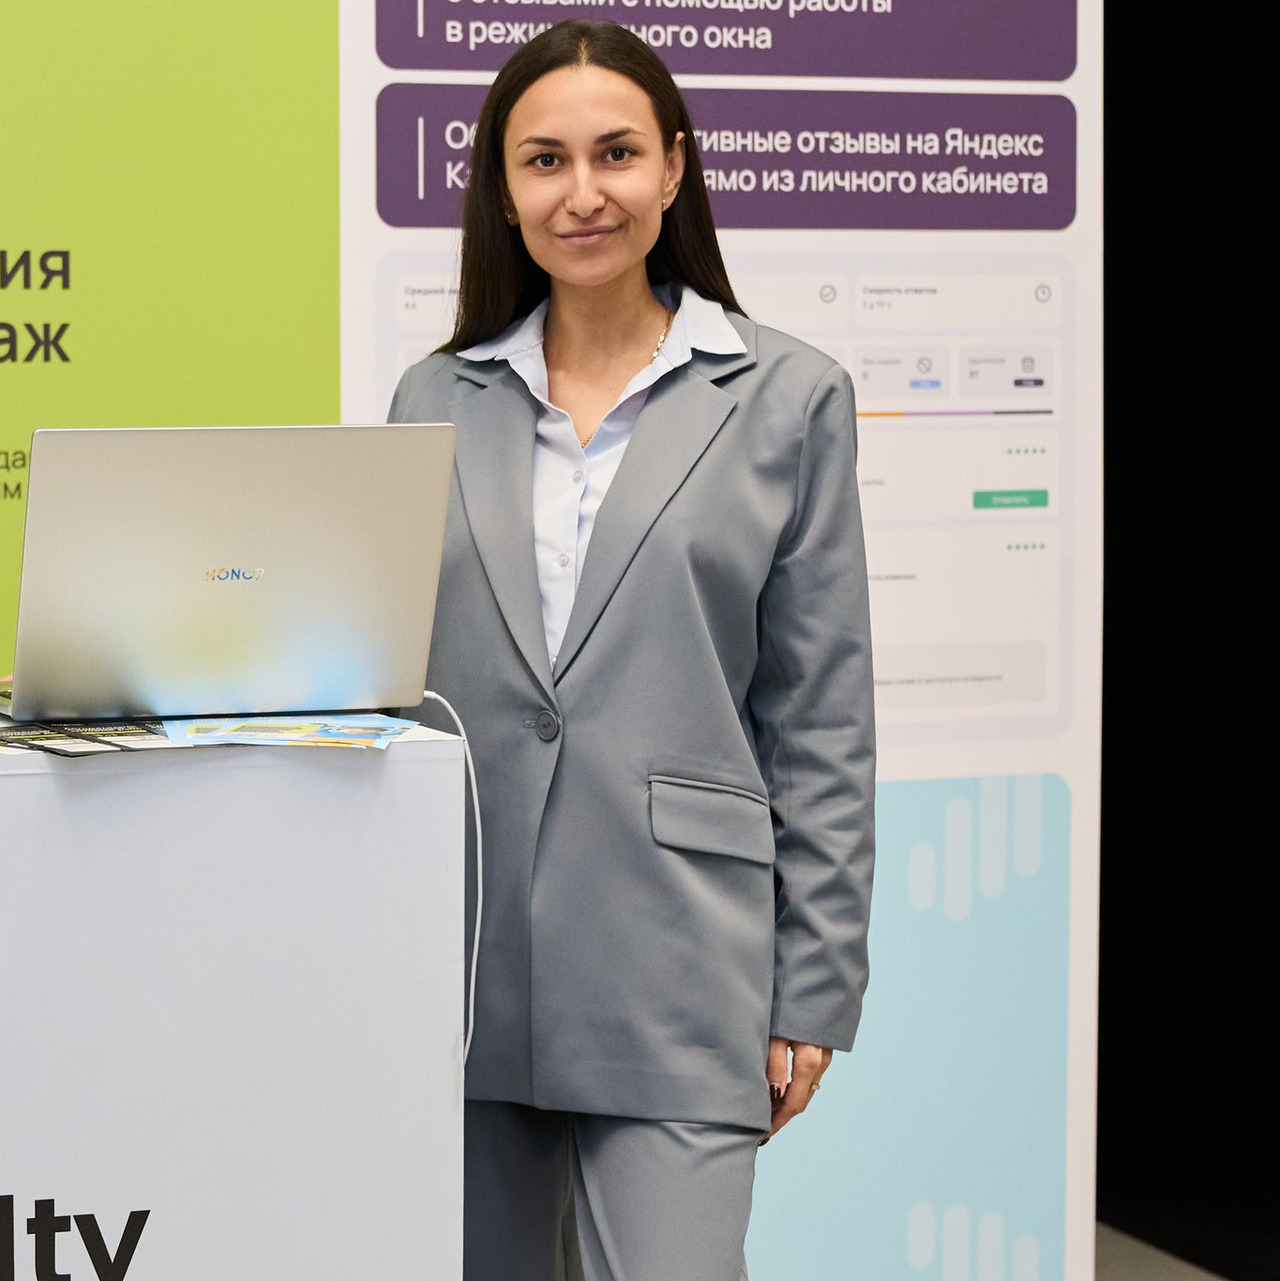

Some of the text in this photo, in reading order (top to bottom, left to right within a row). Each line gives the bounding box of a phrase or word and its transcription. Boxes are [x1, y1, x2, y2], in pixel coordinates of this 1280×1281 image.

[445, 21, 772, 51] в режи ного окна
[797, 131, 900, 154] отзывы
[906, 132, 939, 156] на
[944, 127, 1044, 159] Яндекс
[703, 165, 1049, 194] ямо из личного кабинета
[205, 567, 265, 581] HONOR
